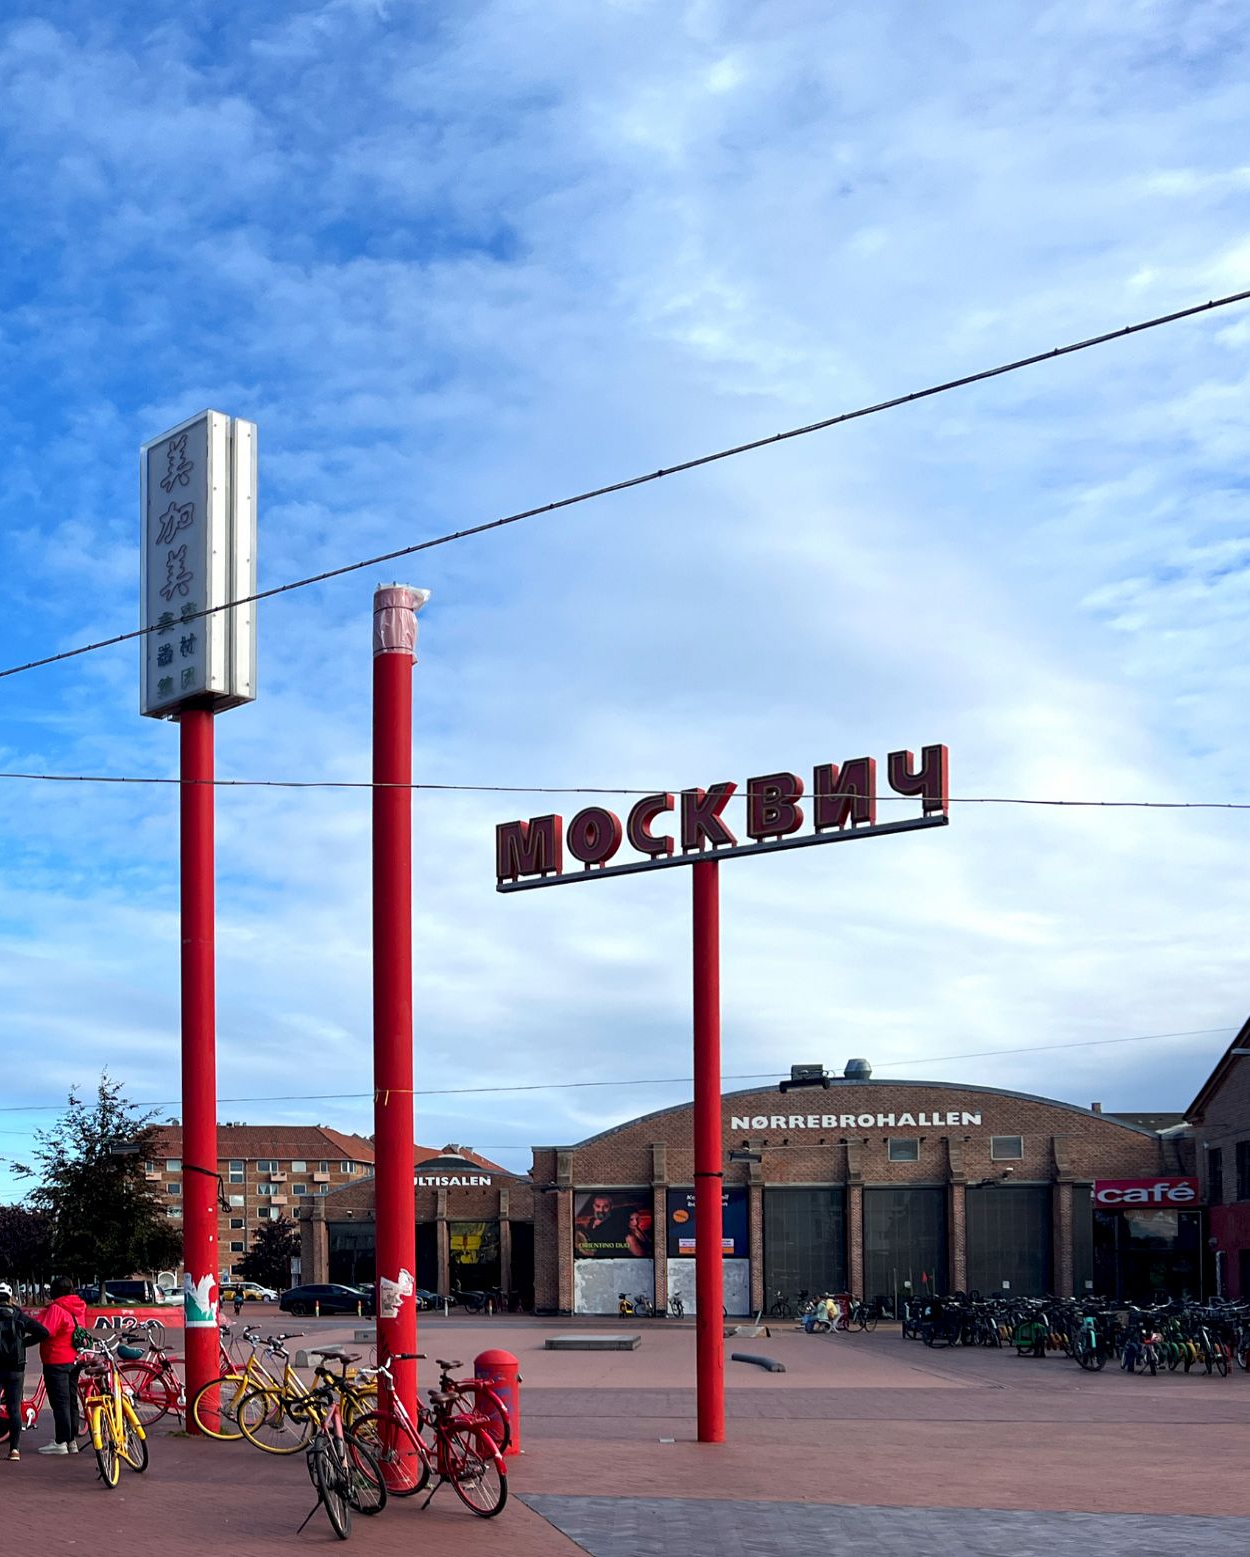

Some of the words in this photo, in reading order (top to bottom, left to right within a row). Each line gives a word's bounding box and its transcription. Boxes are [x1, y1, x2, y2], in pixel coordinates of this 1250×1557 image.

[155, 434, 194, 601] 美加美
[495, 744, 948, 880] МОСКВИЧ
[731, 1111, 982, 1130] NØRREBROHALLEN
[1097, 1182, 1195, 1203] café
